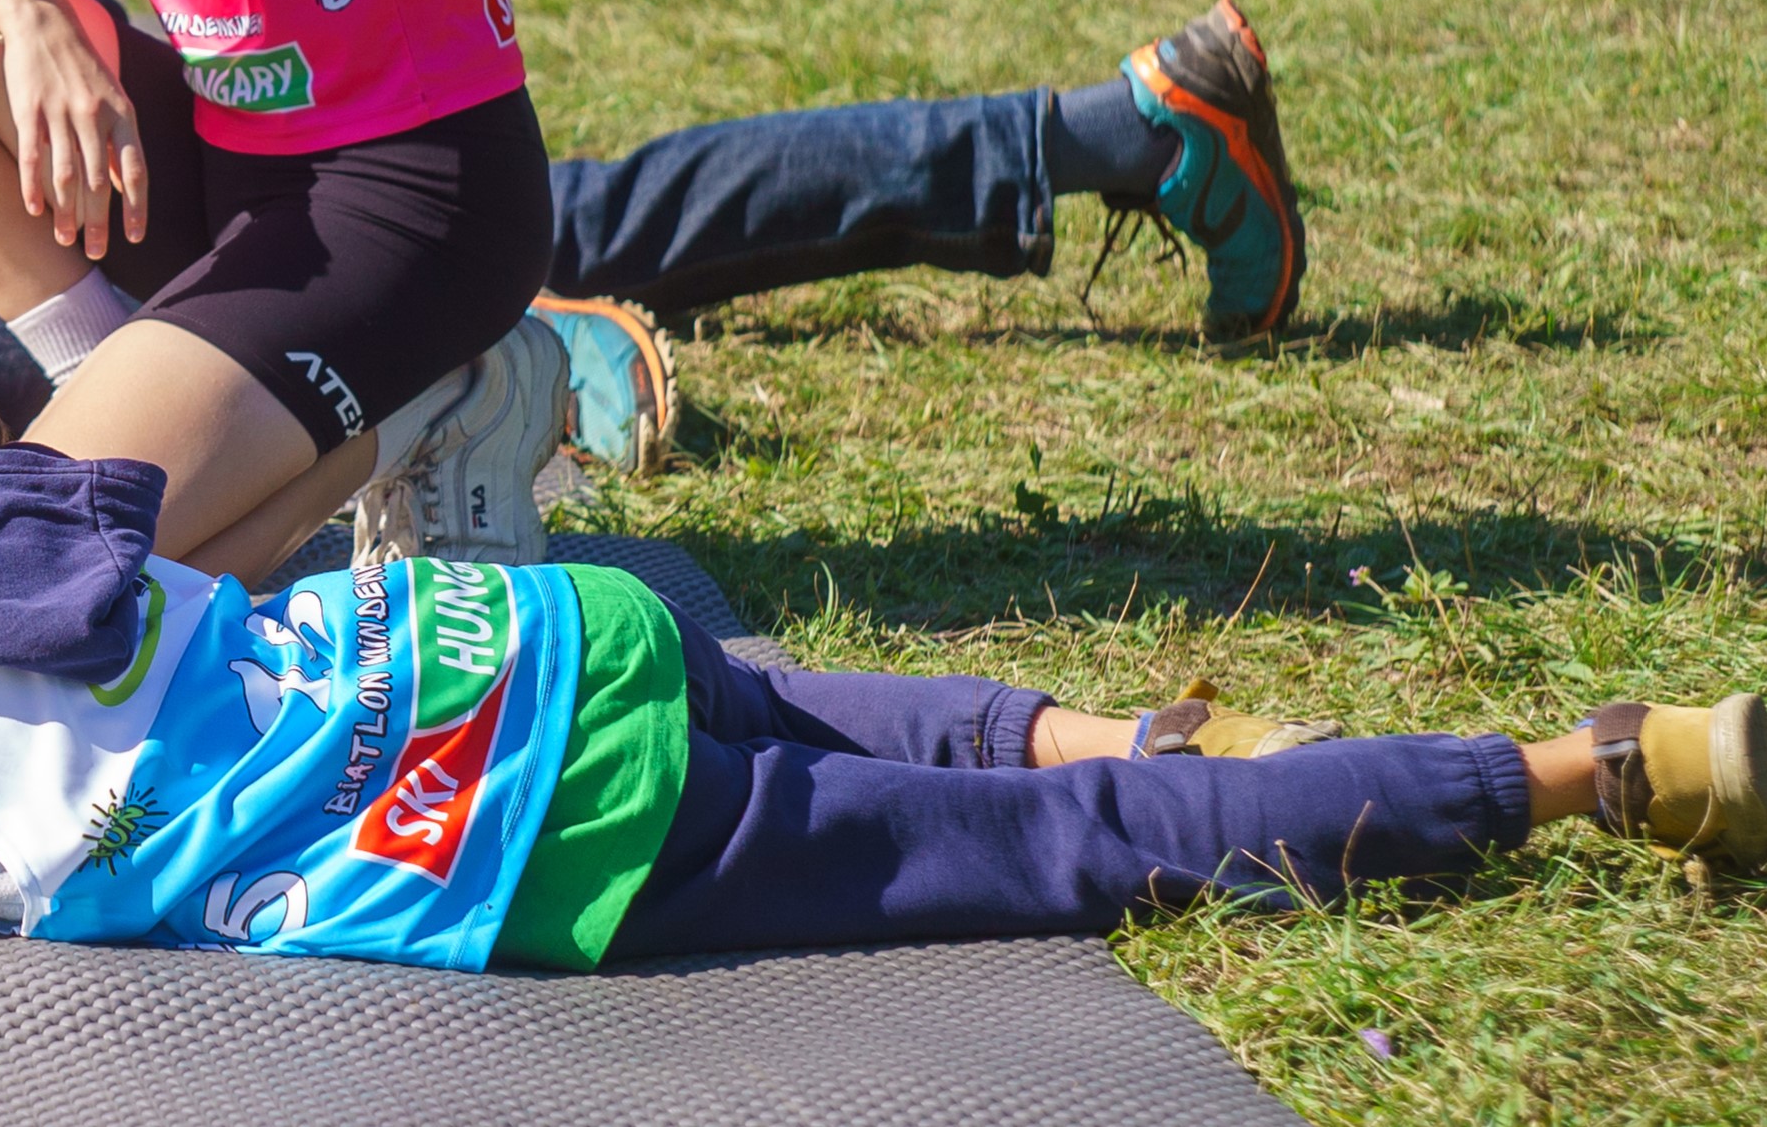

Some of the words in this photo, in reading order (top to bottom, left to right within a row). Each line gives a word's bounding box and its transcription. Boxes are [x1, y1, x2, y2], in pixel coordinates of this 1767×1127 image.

[470, 484, 487, 529] FILA
[385, 758, 460, 847] SKI
[427, 557, 497, 676] HUNG
